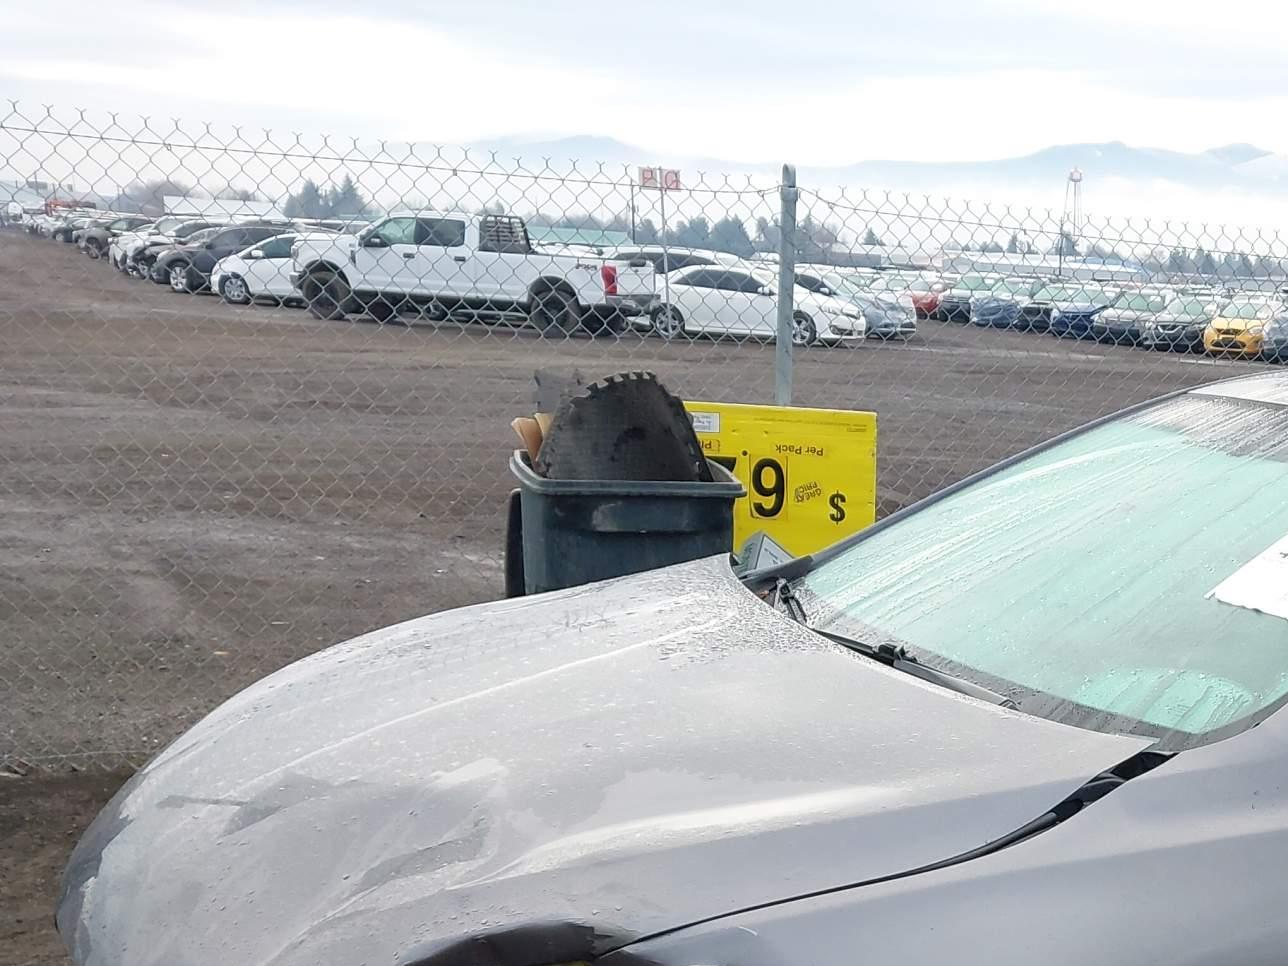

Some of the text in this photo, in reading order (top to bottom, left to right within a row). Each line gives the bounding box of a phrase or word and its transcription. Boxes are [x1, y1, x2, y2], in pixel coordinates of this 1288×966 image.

[774, 444, 824, 456] Per Pack
[828, 490, 847, 525] $
